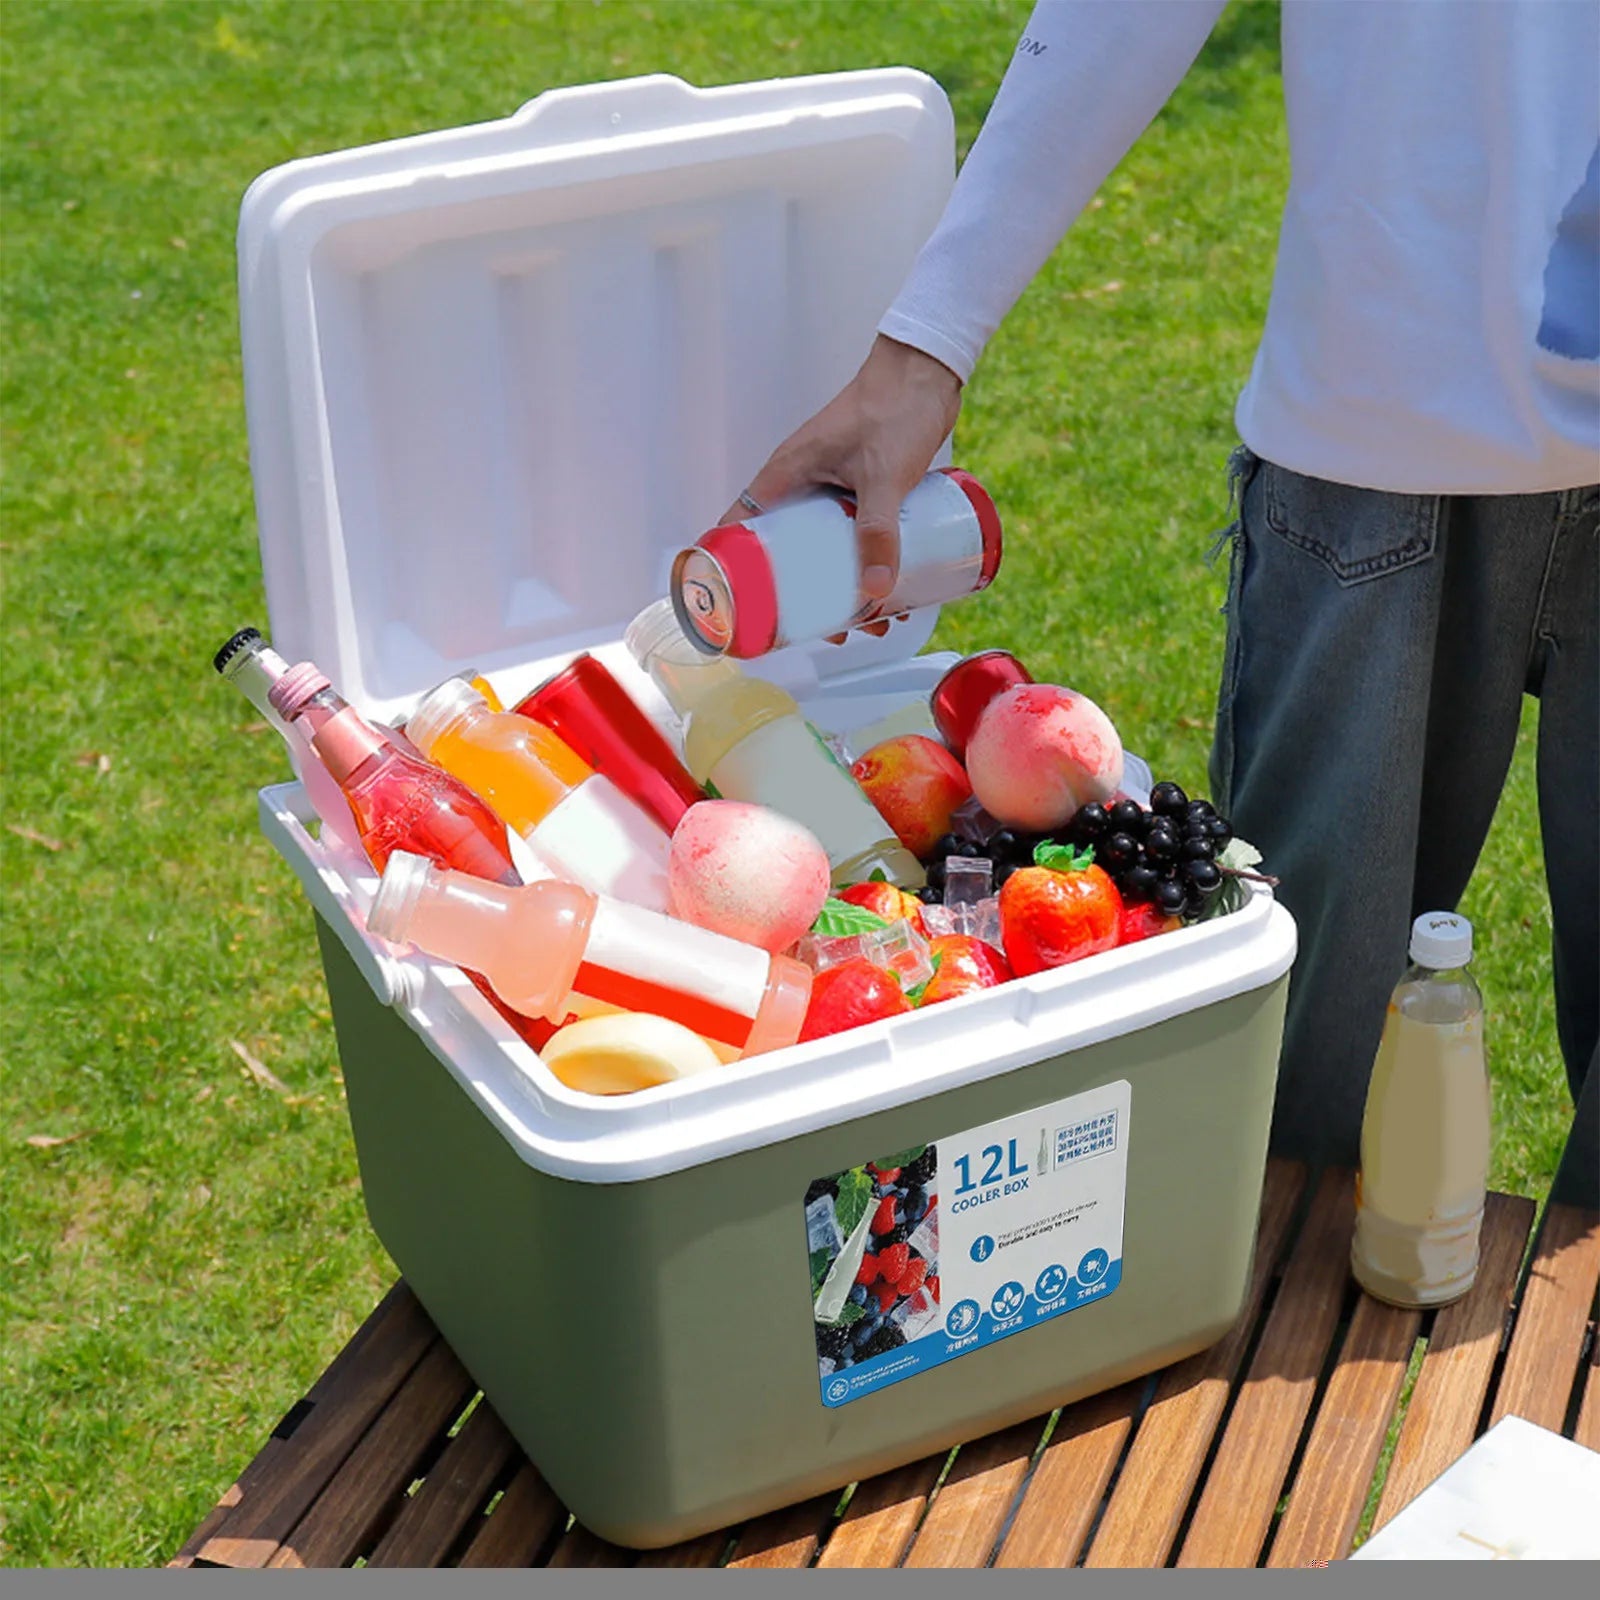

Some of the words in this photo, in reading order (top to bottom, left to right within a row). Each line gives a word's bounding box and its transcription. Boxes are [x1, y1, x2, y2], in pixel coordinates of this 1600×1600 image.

[954, 1138, 1028, 1195] 12L
[951, 1188, 1001, 1214] COOLER
[1004, 1177, 1029, 1196] BOX
